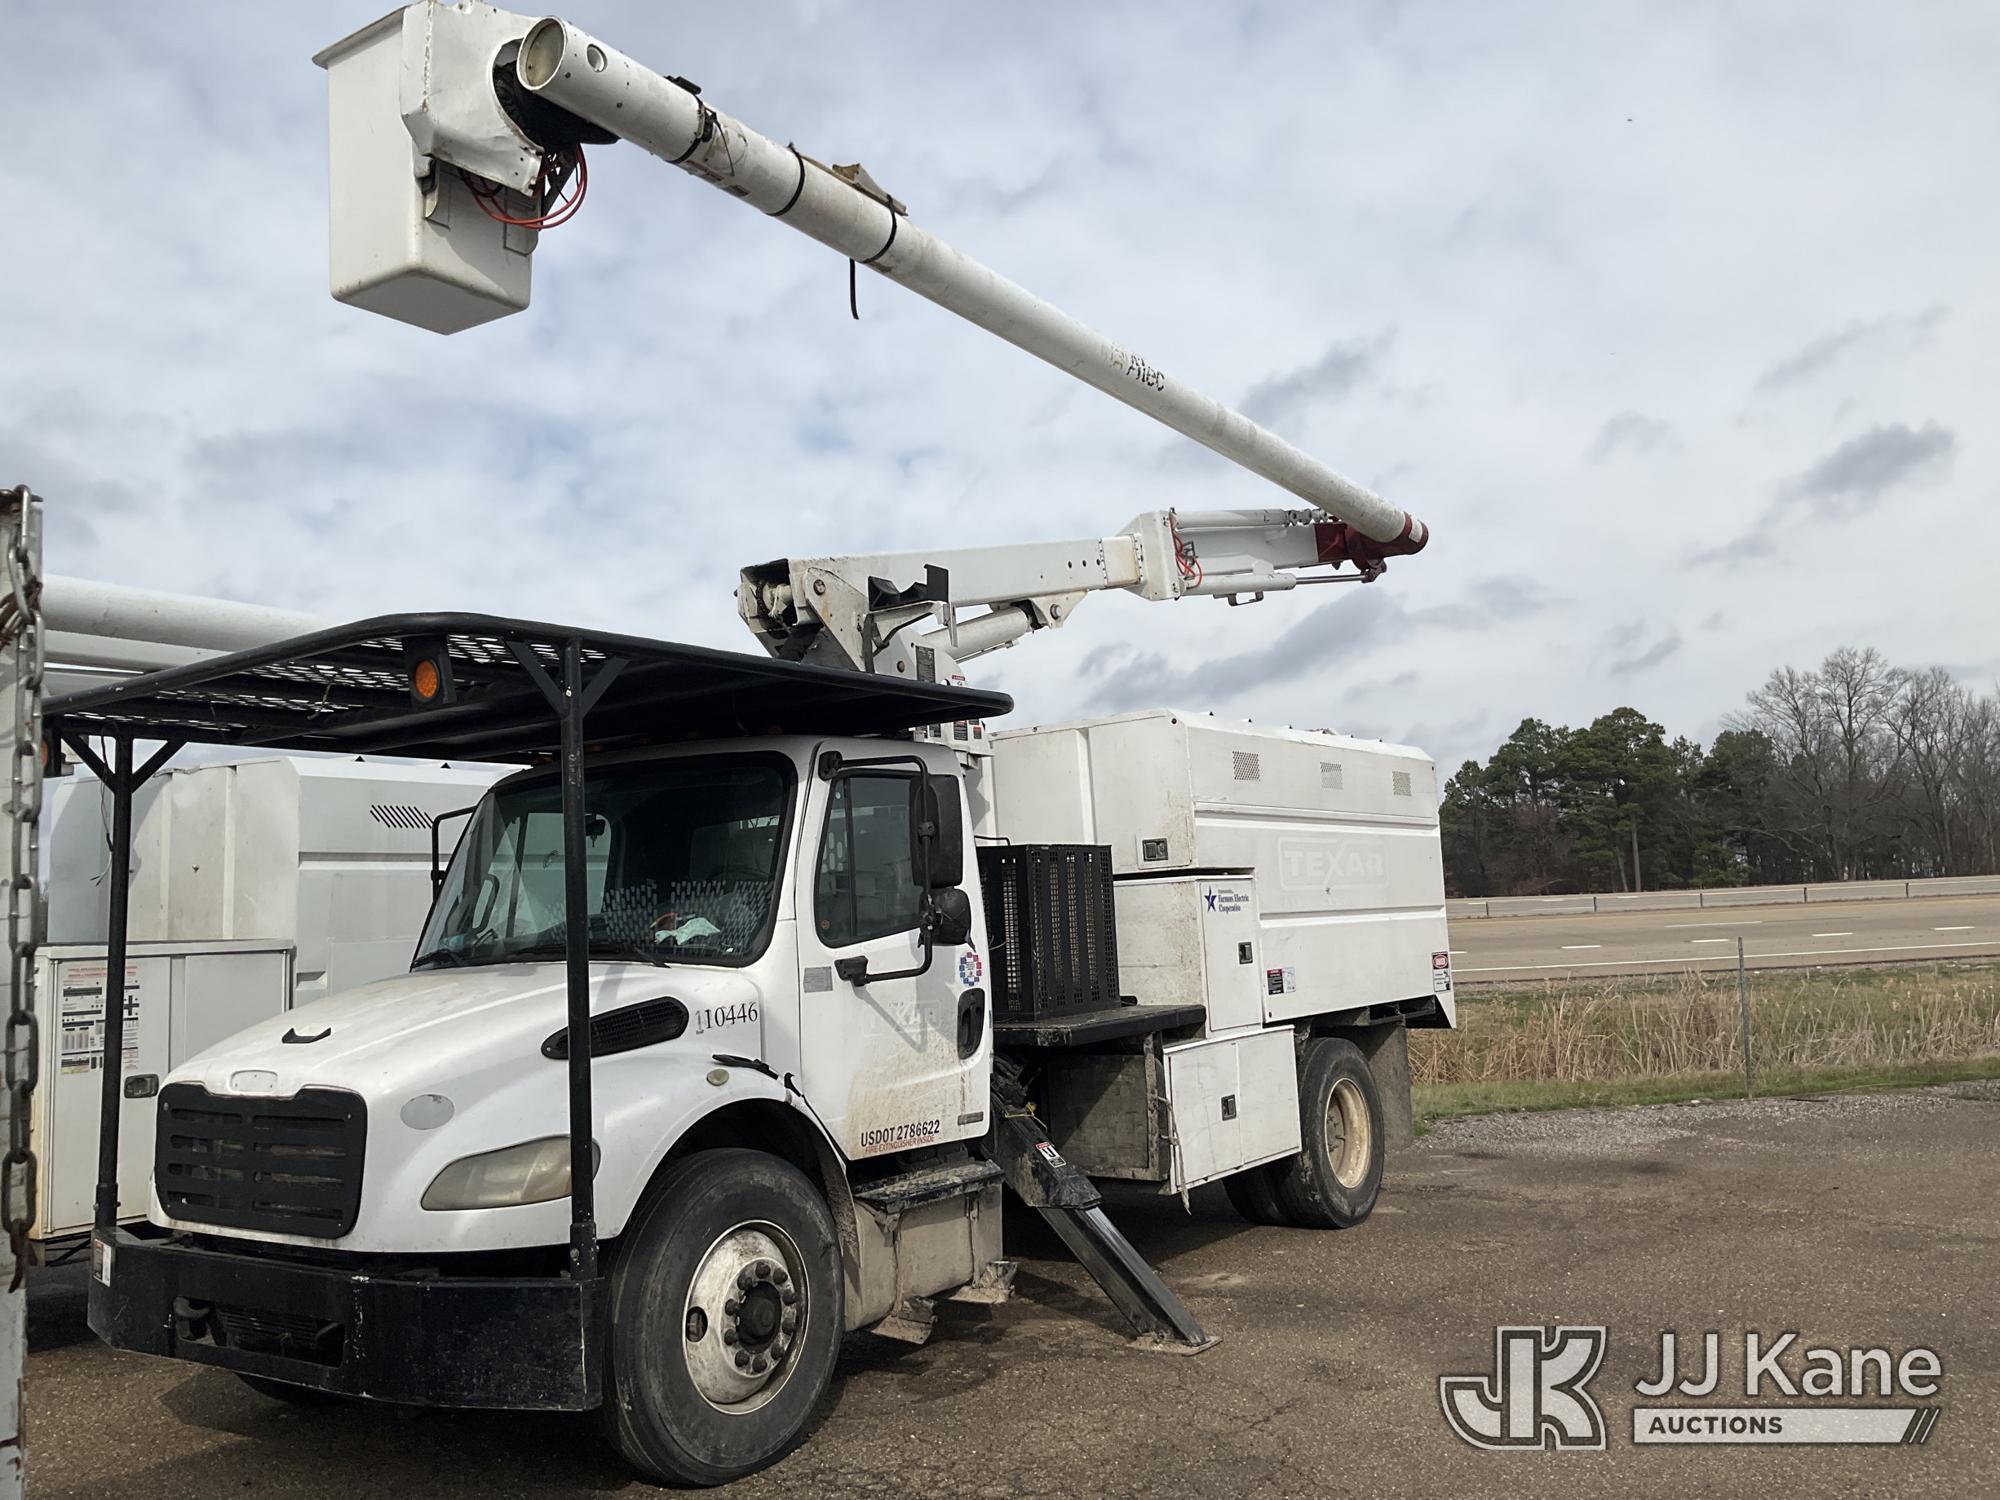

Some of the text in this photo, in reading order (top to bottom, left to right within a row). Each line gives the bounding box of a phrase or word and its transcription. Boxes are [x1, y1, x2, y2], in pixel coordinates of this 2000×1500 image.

[695, 1002, 758, 1034] 110446
[861, 1119, 940, 1147] USDOT 2786622
